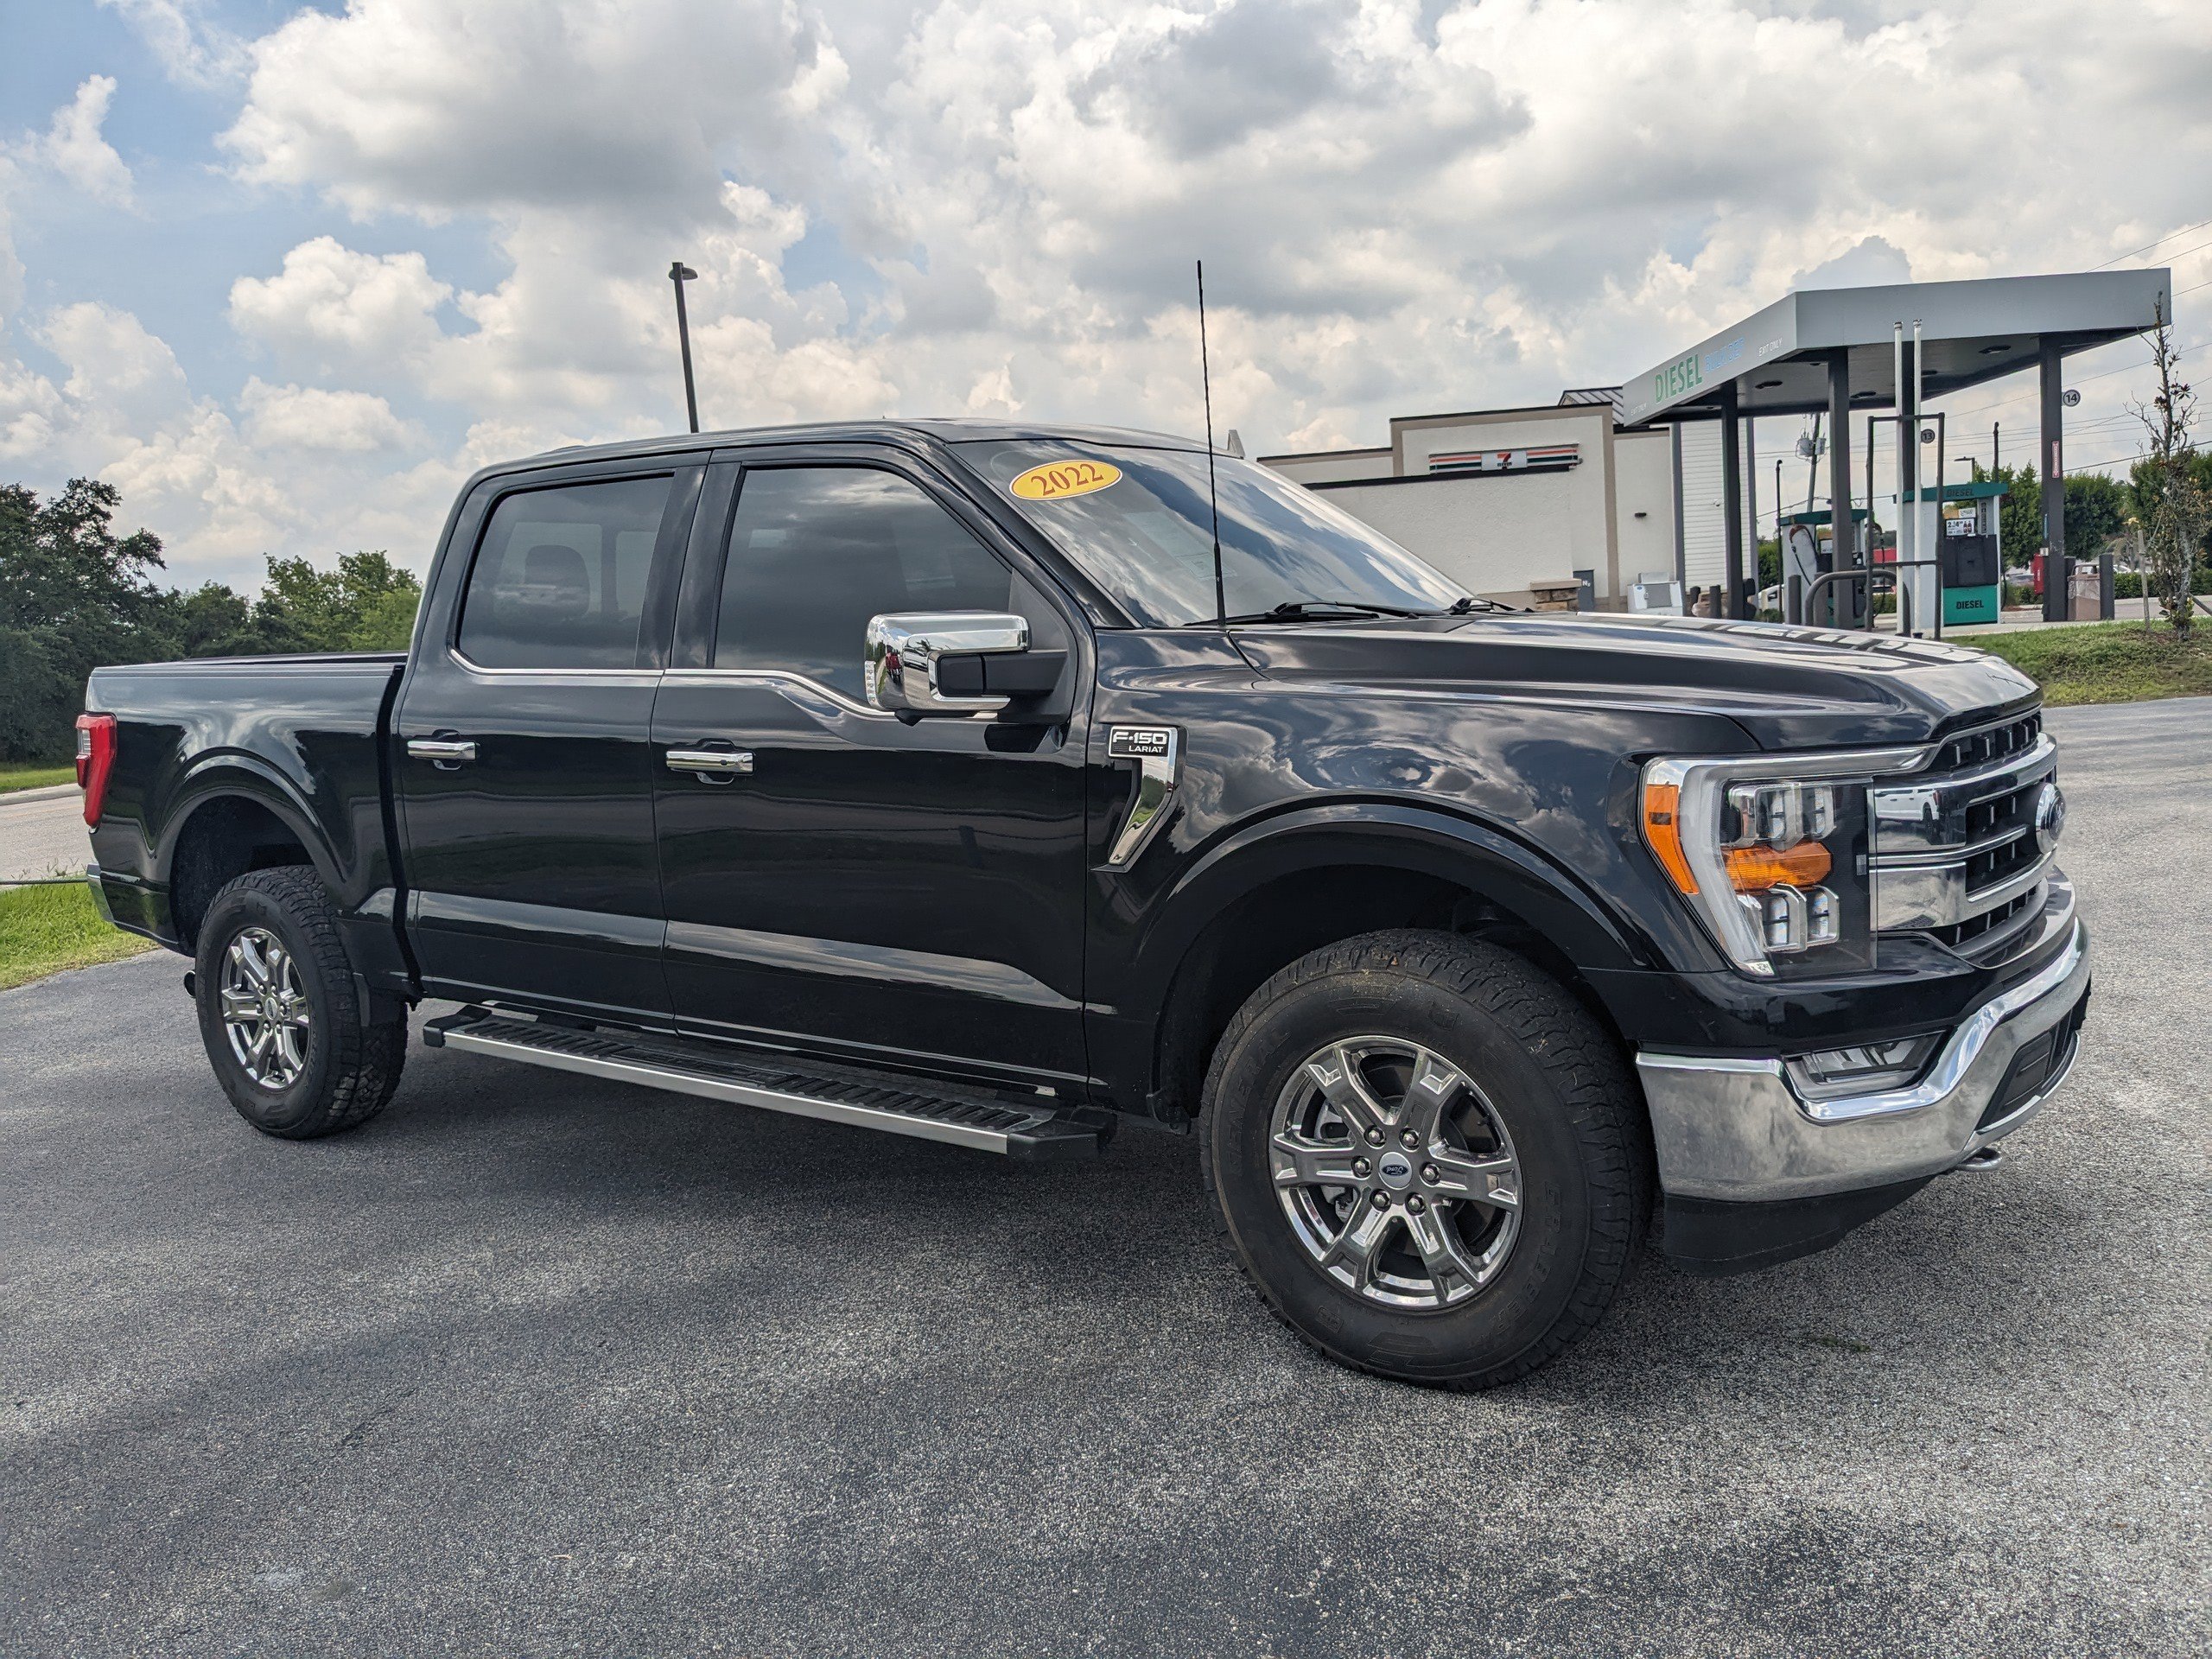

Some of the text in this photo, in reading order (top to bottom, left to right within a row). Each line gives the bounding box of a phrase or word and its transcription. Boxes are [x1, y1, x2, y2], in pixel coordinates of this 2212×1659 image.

[1655, 354, 1703, 404] DIESEL
[2066, 393, 2077, 404] 14
[1923, 432, 1933, 441] 13
[1031, 463, 1103, 496] 2022
[1946, 488, 1974, 497] DIESEL
[1956, 600, 1984, 609] DIESEL
[1113, 731, 1167, 744] F-150
